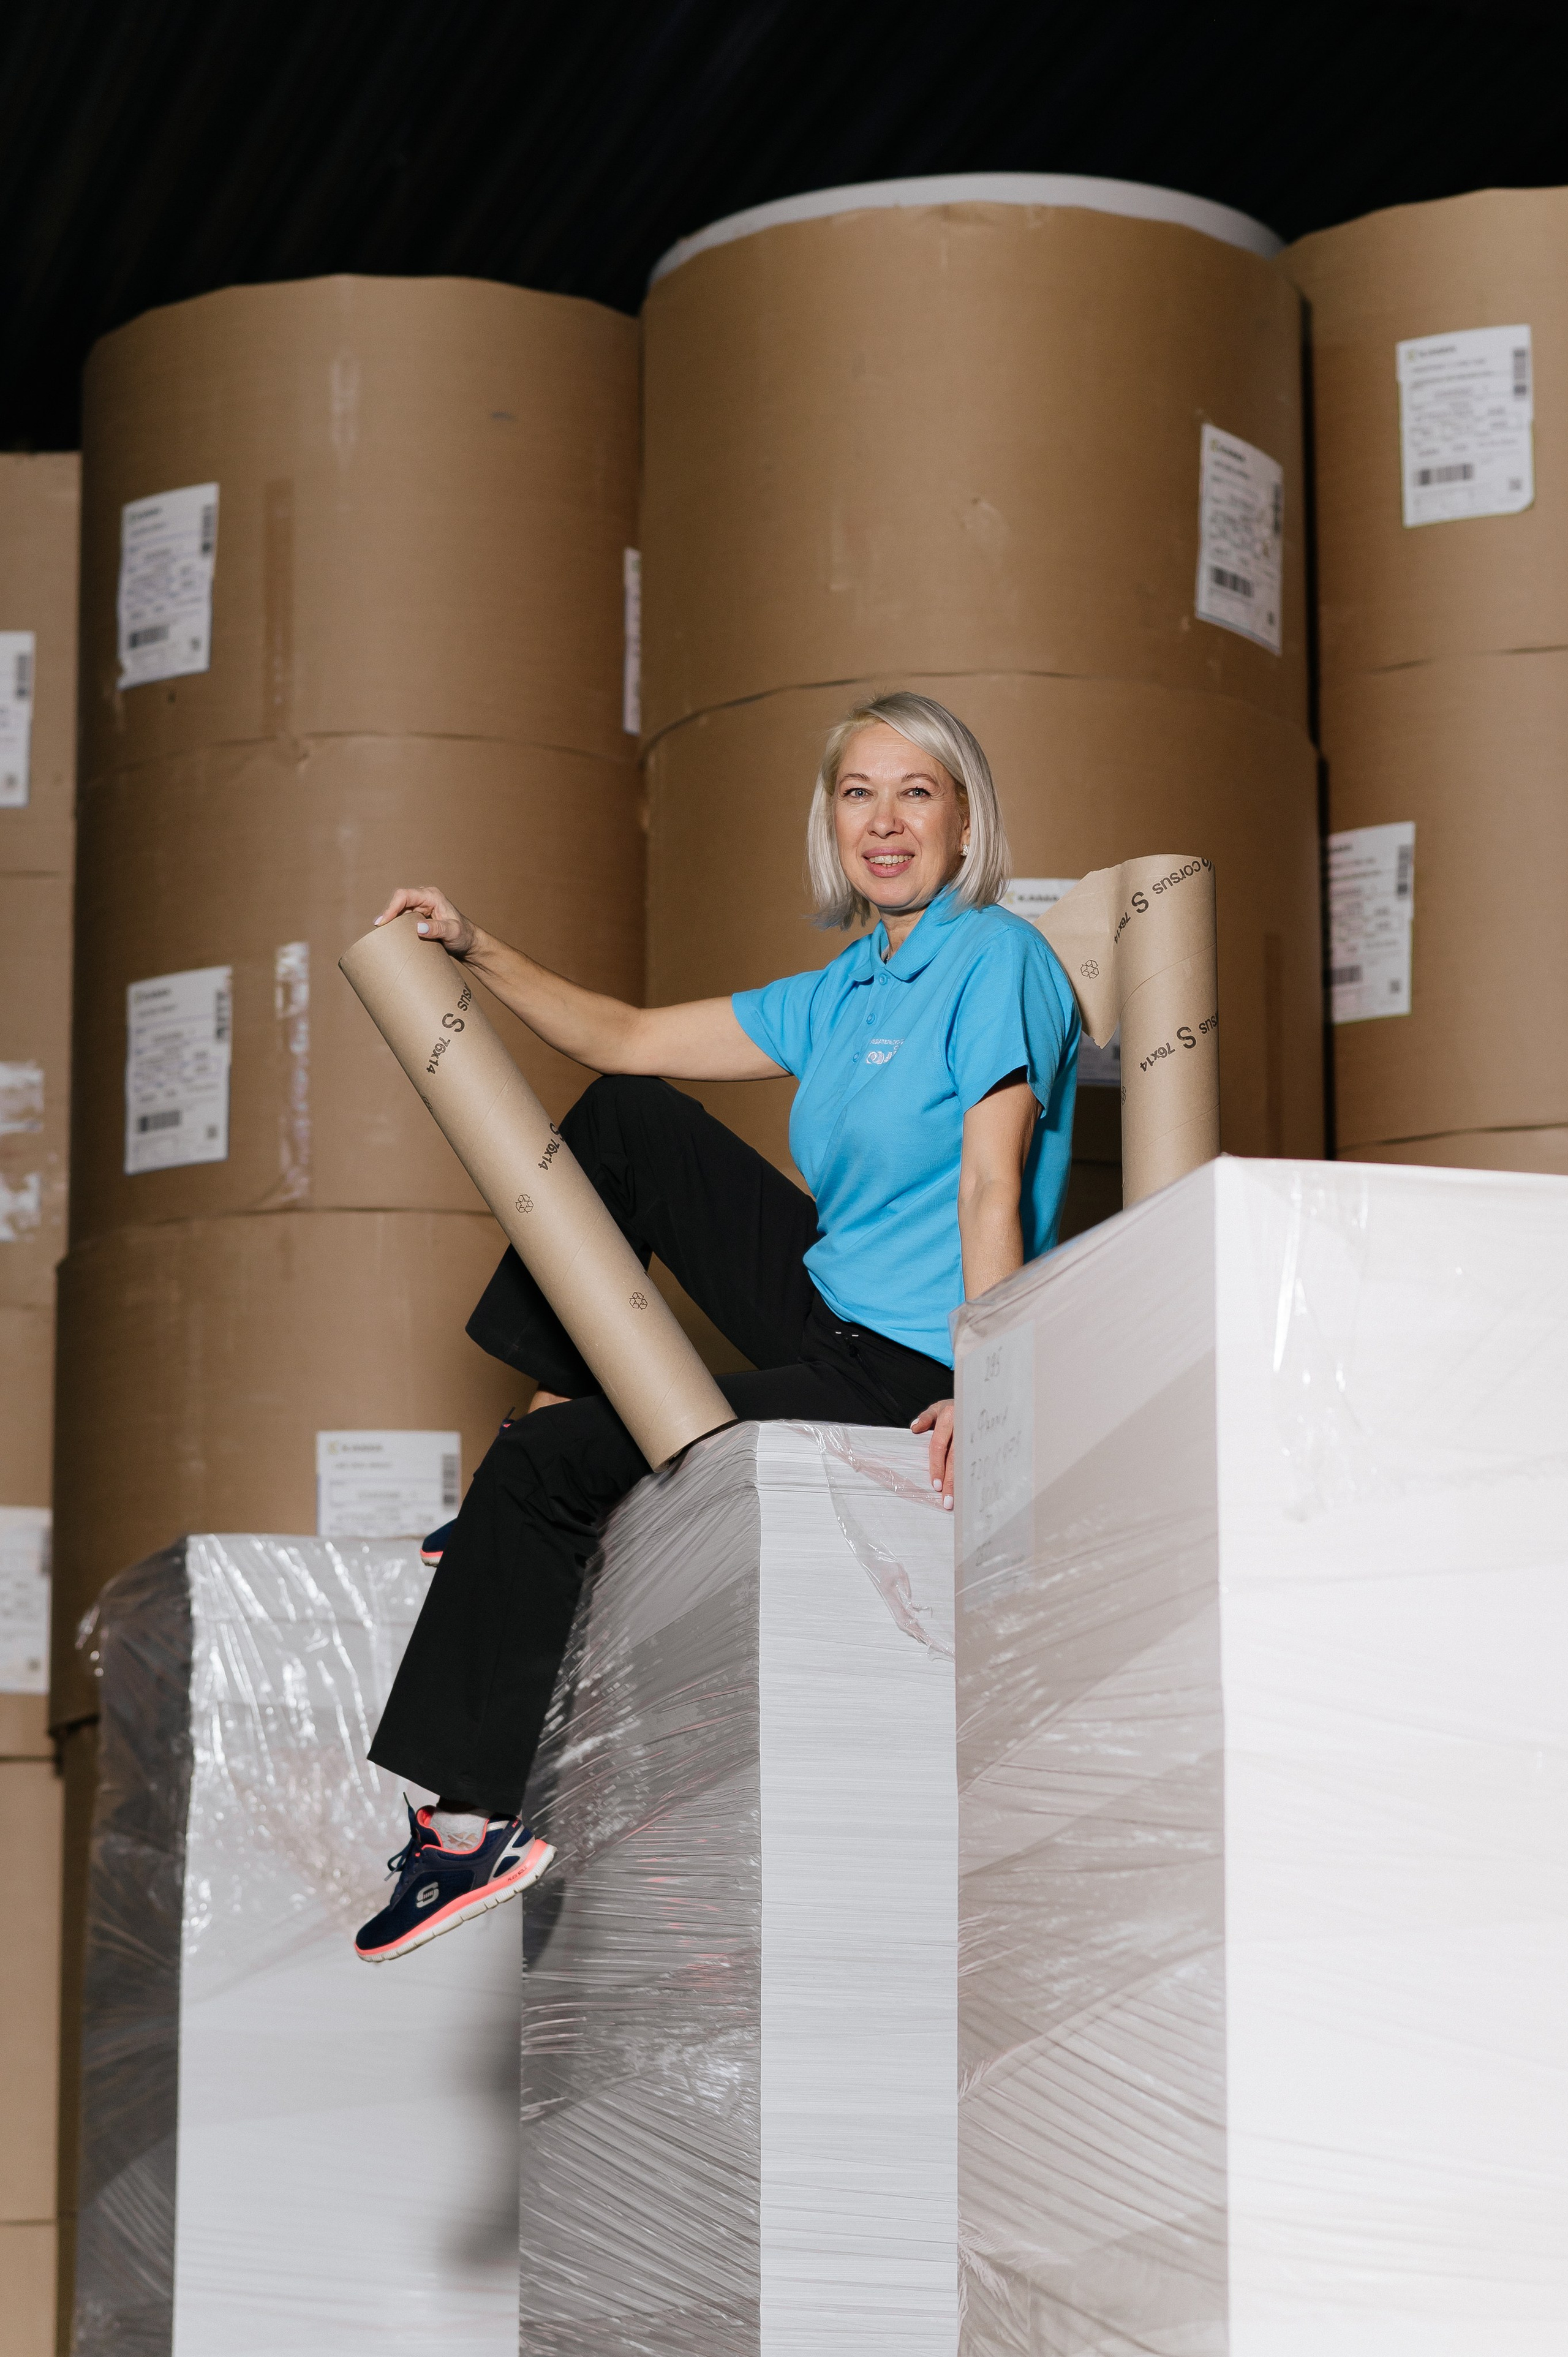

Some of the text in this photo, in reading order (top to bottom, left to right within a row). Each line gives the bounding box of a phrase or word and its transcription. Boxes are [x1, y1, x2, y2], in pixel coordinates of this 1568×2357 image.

[1114, 861, 1200, 945] corsus S 76x14
[426, 982, 472, 1074] rsus S 76x14
[1177, 1026, 1196, 1049] S
[1140, 1043, 1175, 1072] 76x14
[538, 1138, 560, 1171] 76x14
